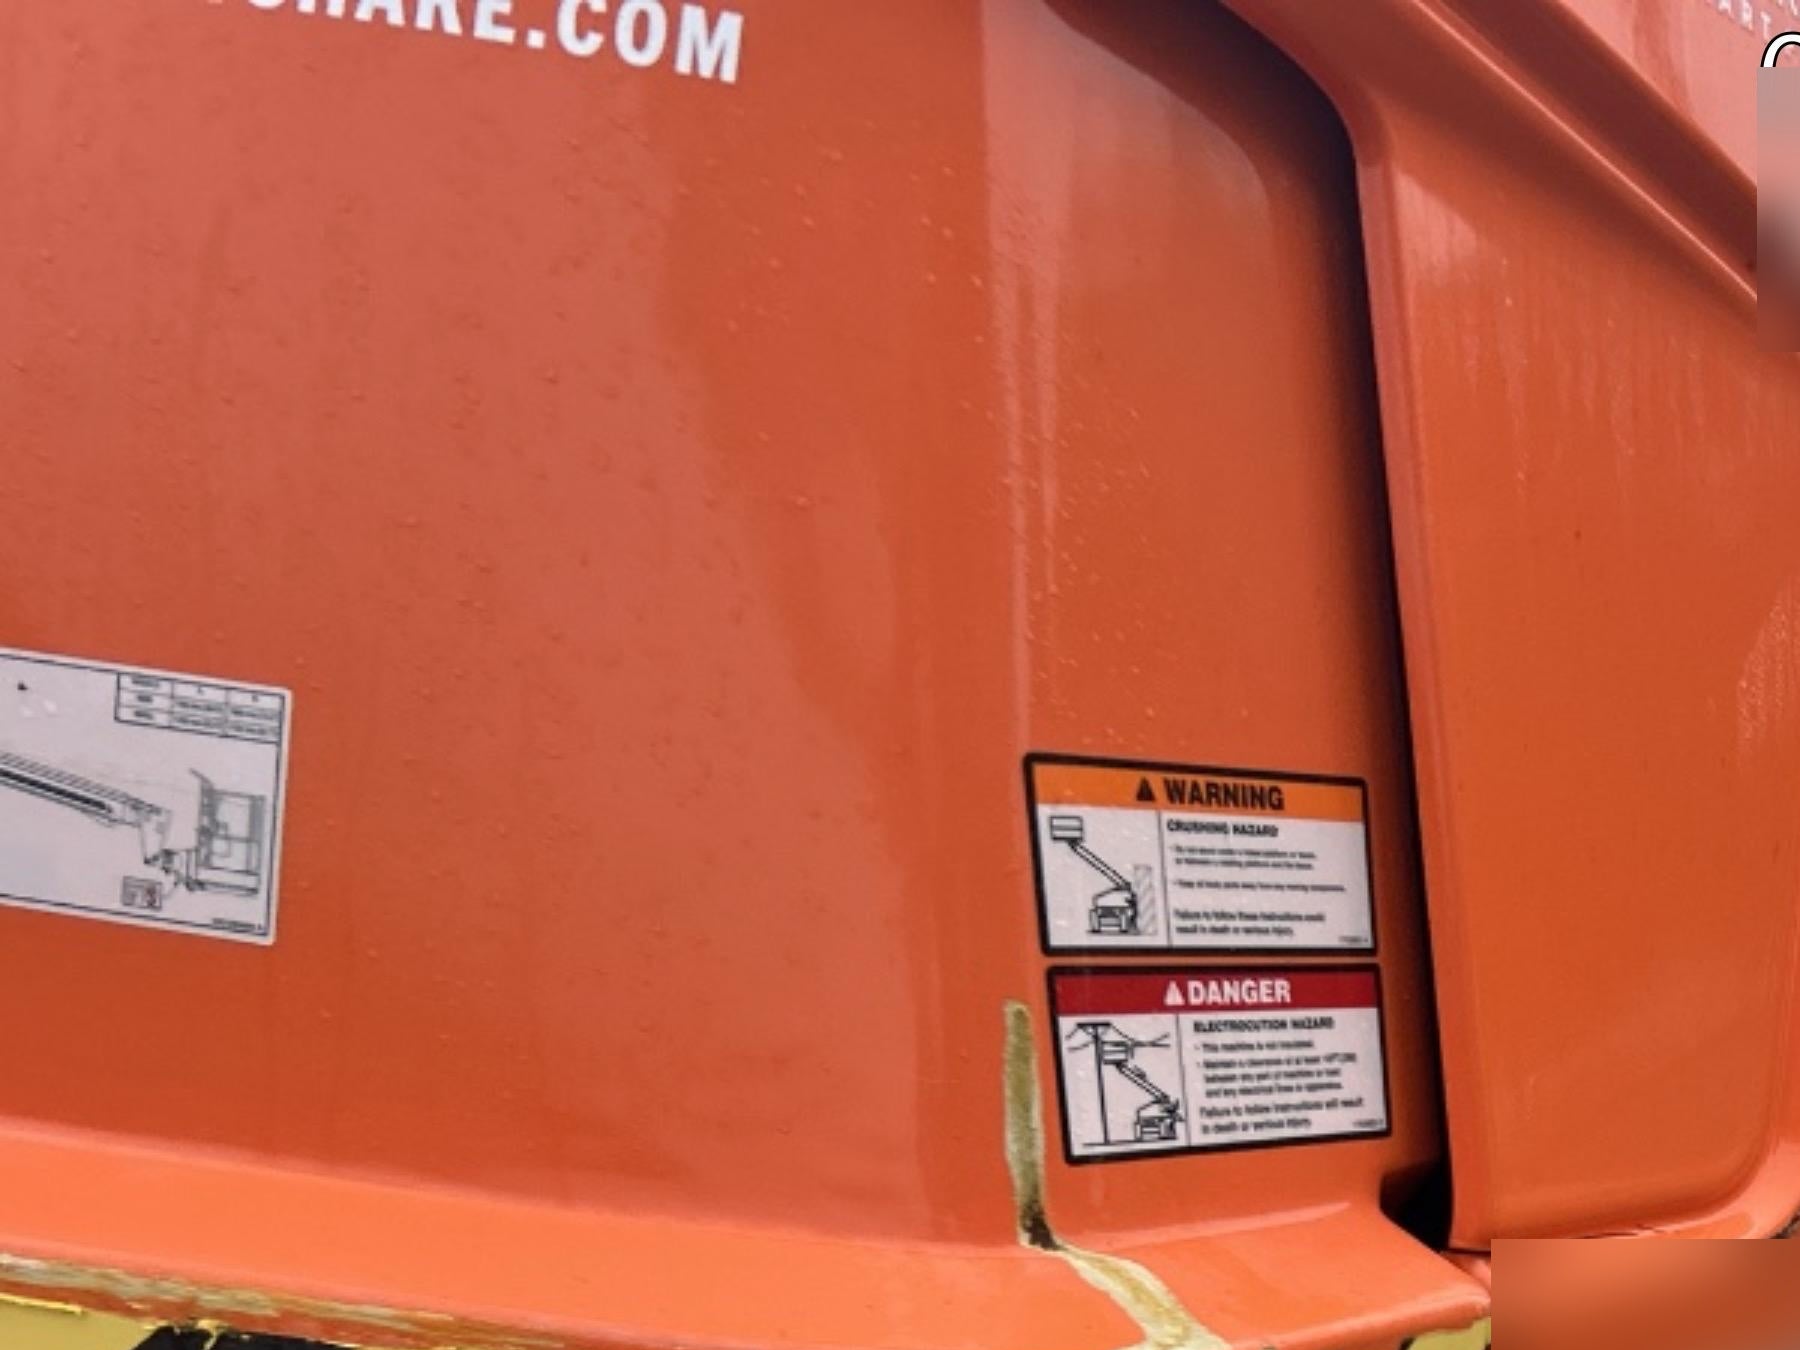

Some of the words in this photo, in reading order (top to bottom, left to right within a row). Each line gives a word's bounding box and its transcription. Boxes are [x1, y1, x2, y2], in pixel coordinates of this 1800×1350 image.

[1163, 777, 1285, 811] WARNING
[1232, 822, 1279, 838] HAZARD
[1187, 980, 1291, 1006] DANGER
[1291, 1016, 1334, 1030] HAZARD
